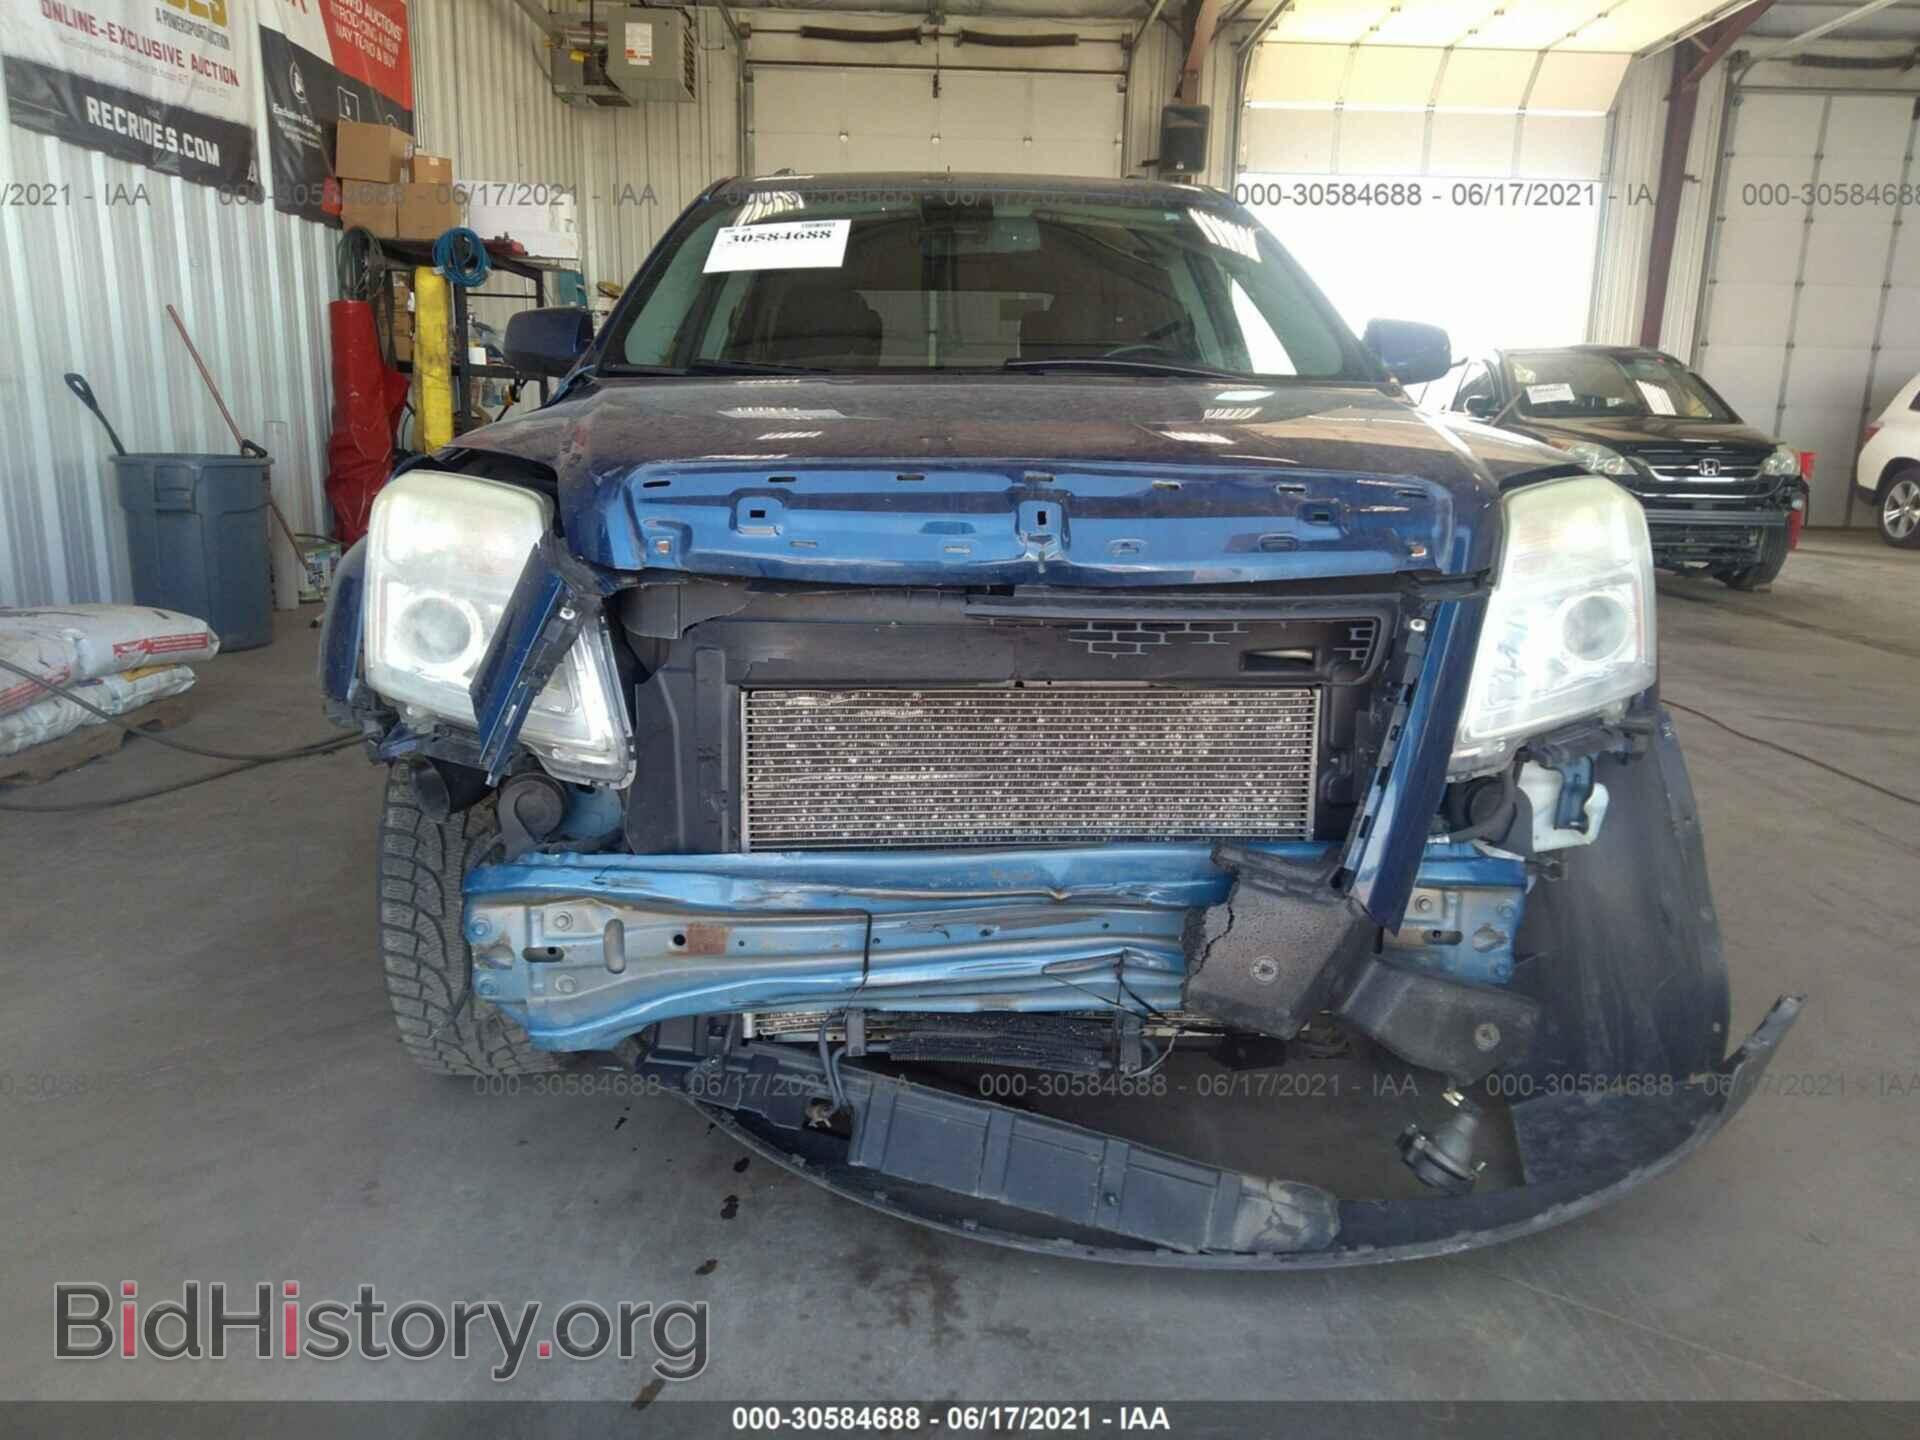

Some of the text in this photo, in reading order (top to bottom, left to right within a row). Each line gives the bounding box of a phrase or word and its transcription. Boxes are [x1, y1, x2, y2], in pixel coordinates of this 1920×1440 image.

[41, 0, 185, 68] ONLINE-EXCLUSIVE
[191, 53, 240, 87] AUCTION
[86, 96, 220, 167] RECRIDES.COM
[727, 230, 832, 244] 30584688
